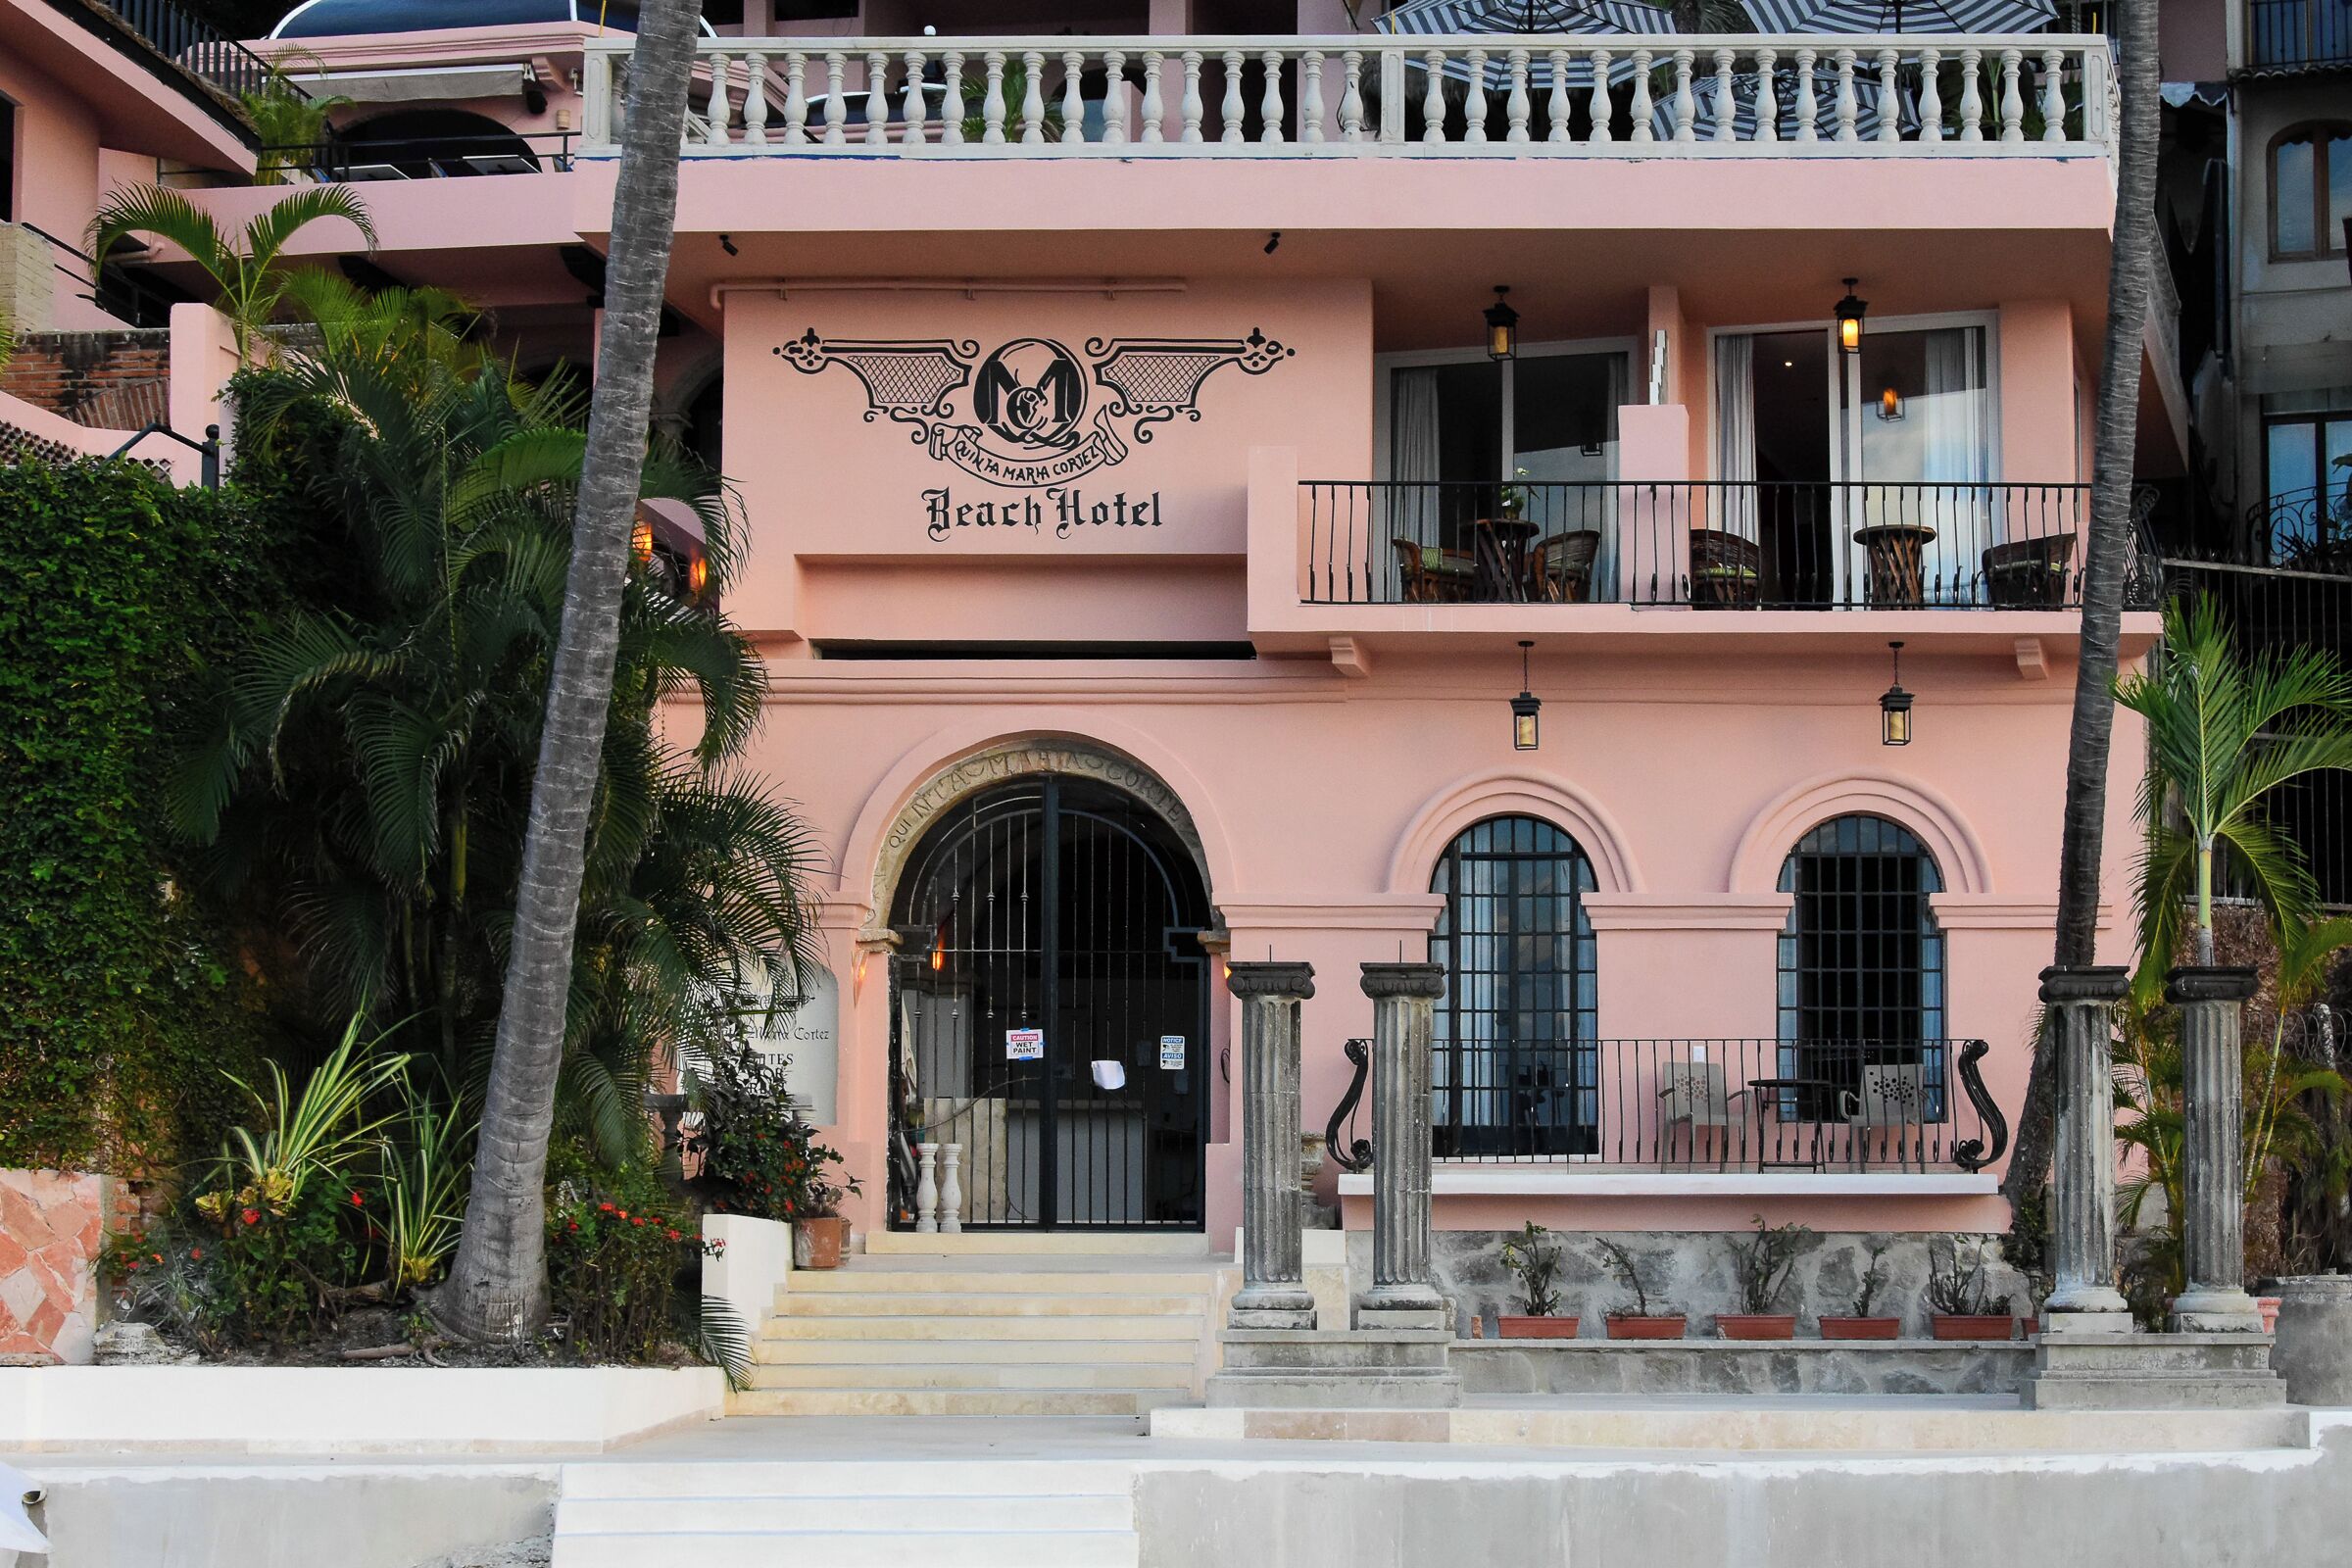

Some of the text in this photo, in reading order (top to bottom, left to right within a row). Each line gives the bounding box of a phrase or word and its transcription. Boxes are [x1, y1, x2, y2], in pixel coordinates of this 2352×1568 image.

[955, 440, 1099, 484] QUINTA MARIA CORTEZ
[921, 486, 1163, 542] Beach Hotel
[1106, 760, 1193, 841] CORTE
[794, 1027, 829, 1040] Cortez
